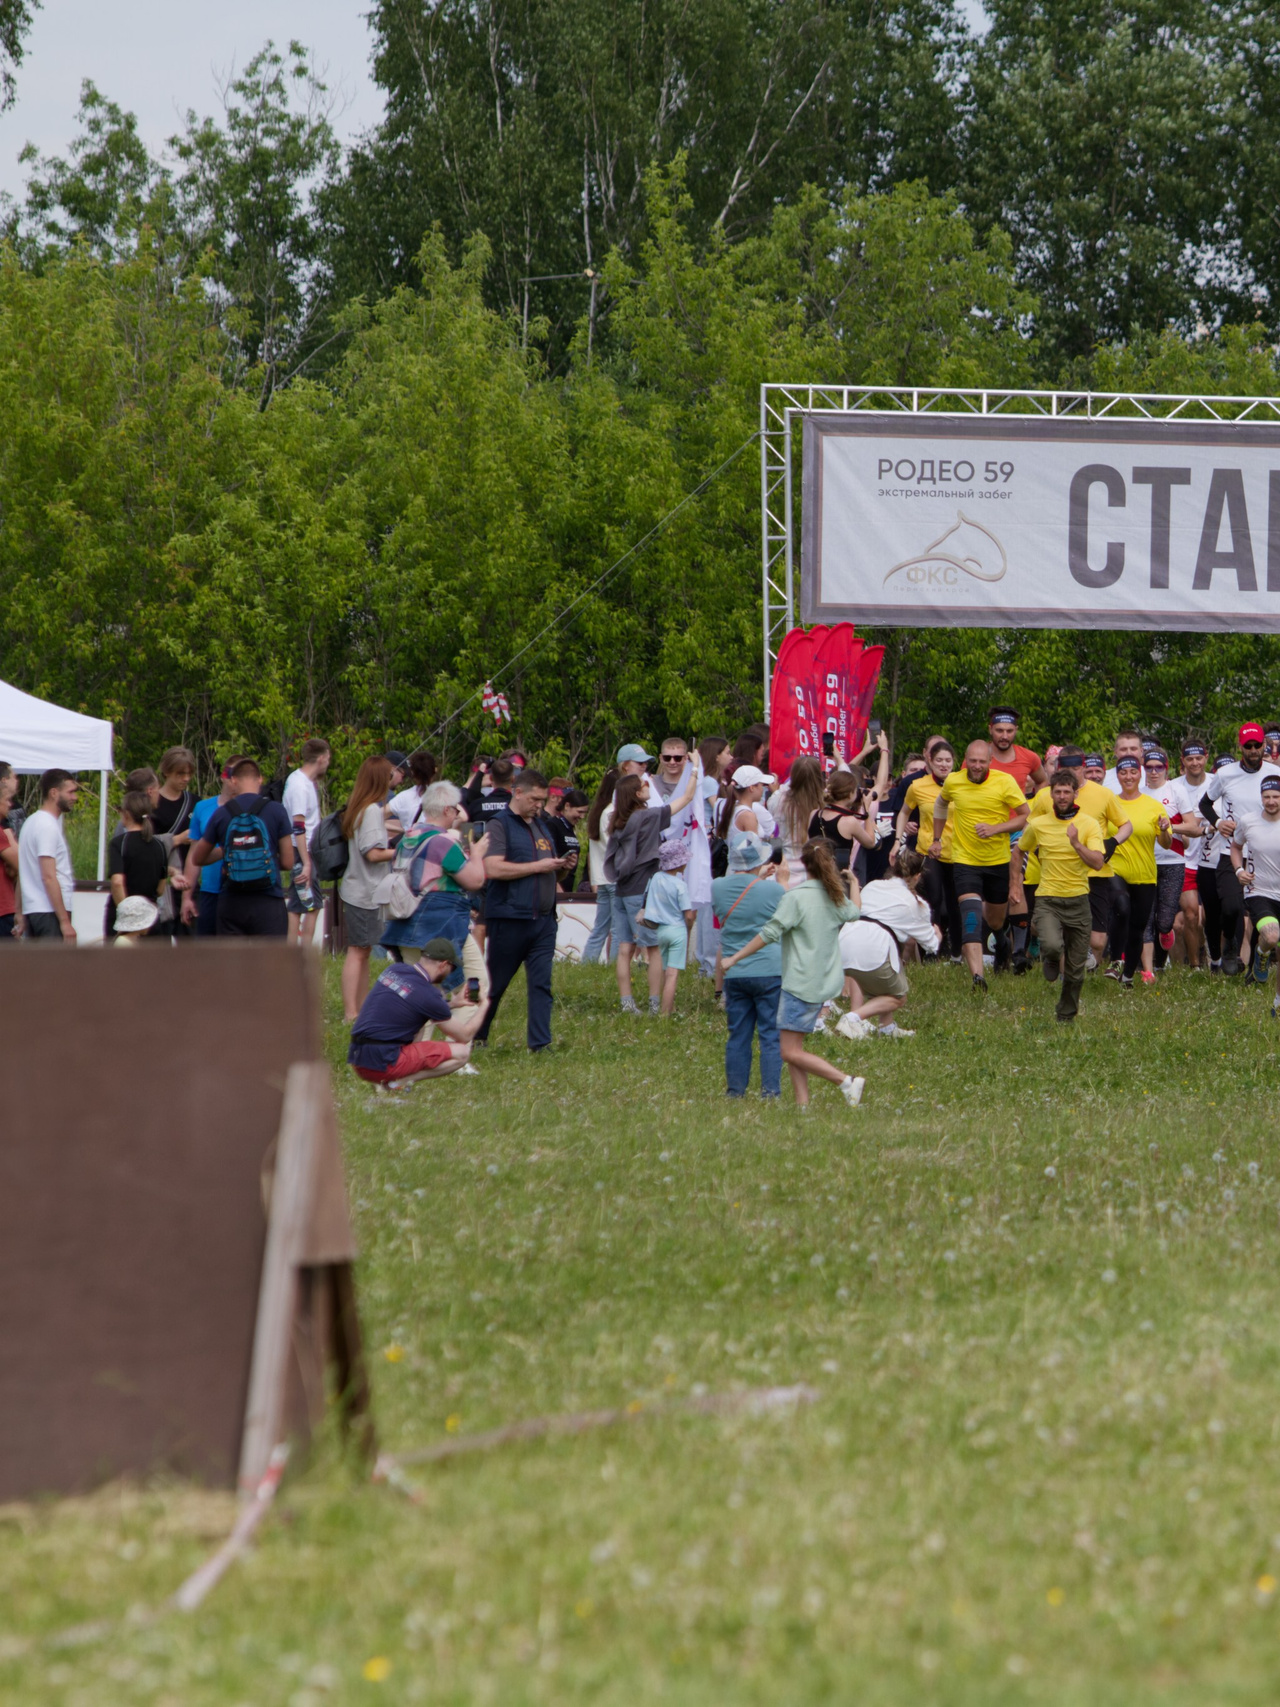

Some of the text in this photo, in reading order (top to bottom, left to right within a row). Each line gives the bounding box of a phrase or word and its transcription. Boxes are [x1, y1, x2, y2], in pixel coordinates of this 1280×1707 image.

[878, 458, 1015, 485] РОДЕО 59
[878, 487, 1013, 499] экстремальный забег
[906, 565, 958, 586] ФКС
[826, 673, 839, 707] 59
[838, 709, 847, 738] забег
